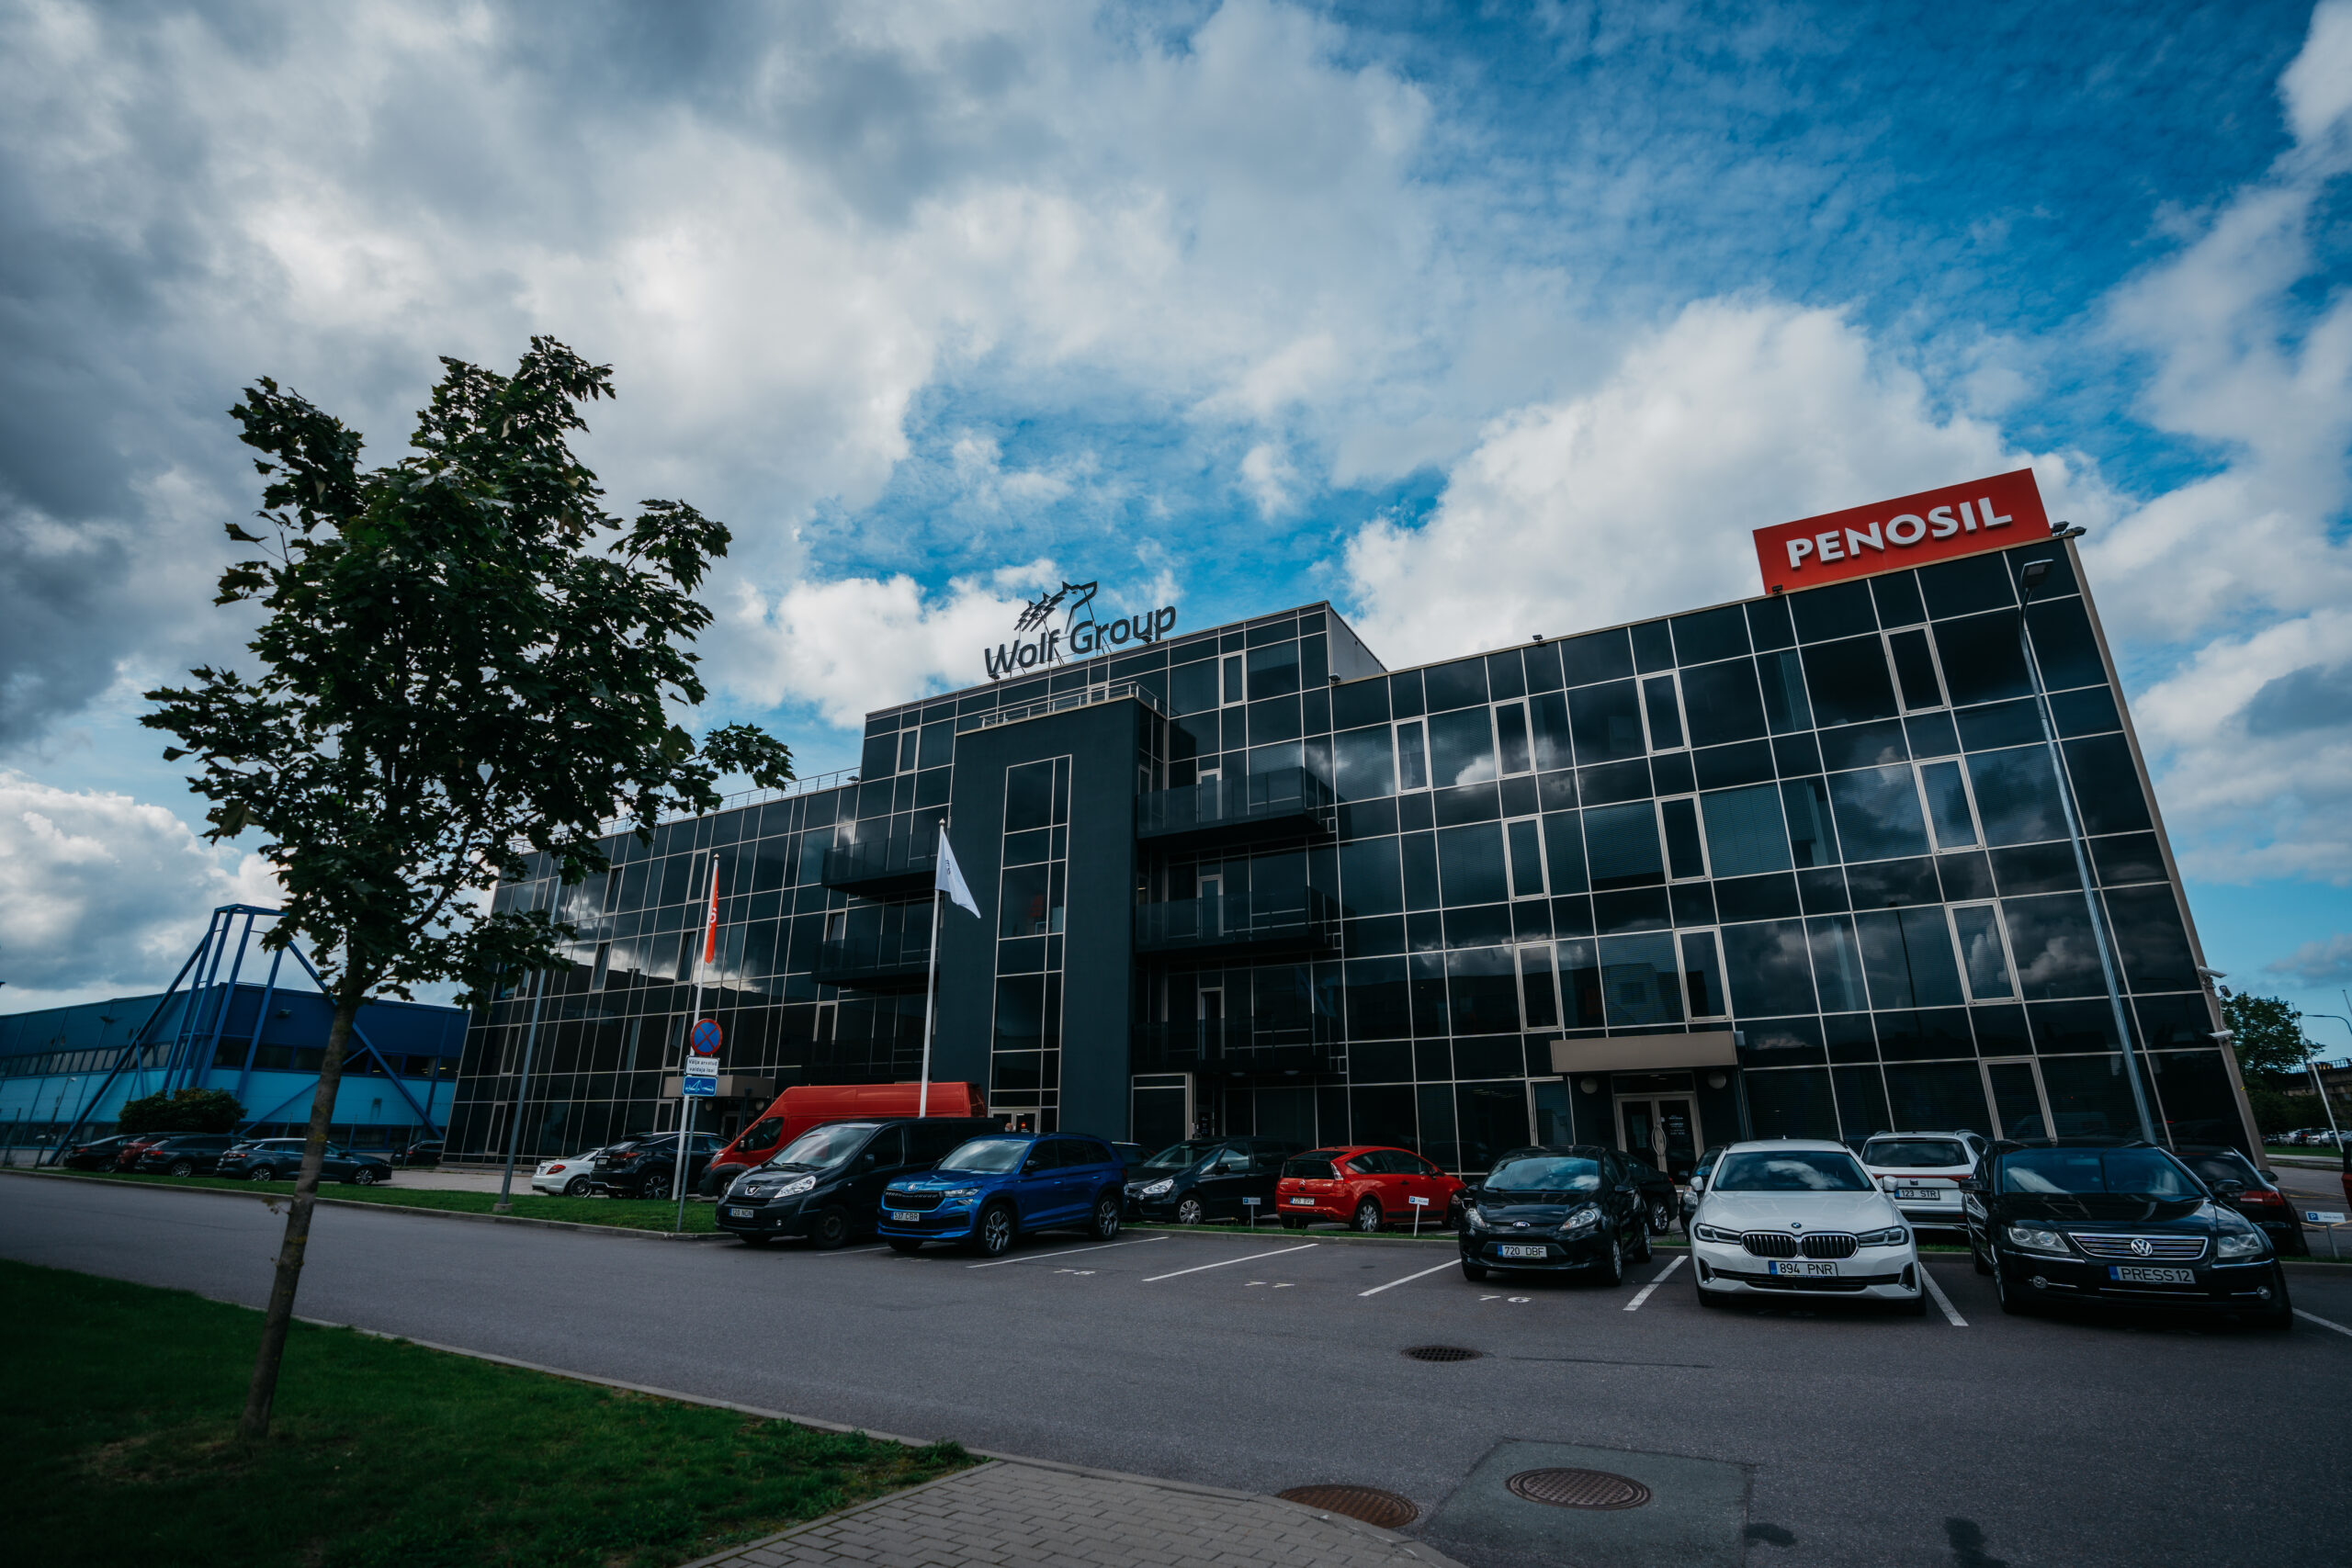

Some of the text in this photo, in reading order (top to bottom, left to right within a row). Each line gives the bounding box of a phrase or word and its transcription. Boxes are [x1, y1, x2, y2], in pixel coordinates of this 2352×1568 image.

[1786, 497, 2012, 570] PENOSIL
[984, 605, 1177, 673] Wolf Group
[894, 1212, 919, 1221] 537 CBR
[1504, 1247, 1544, 1257] 720 DBF
[1780, 1263, 1833, 1275] 894 PNR
